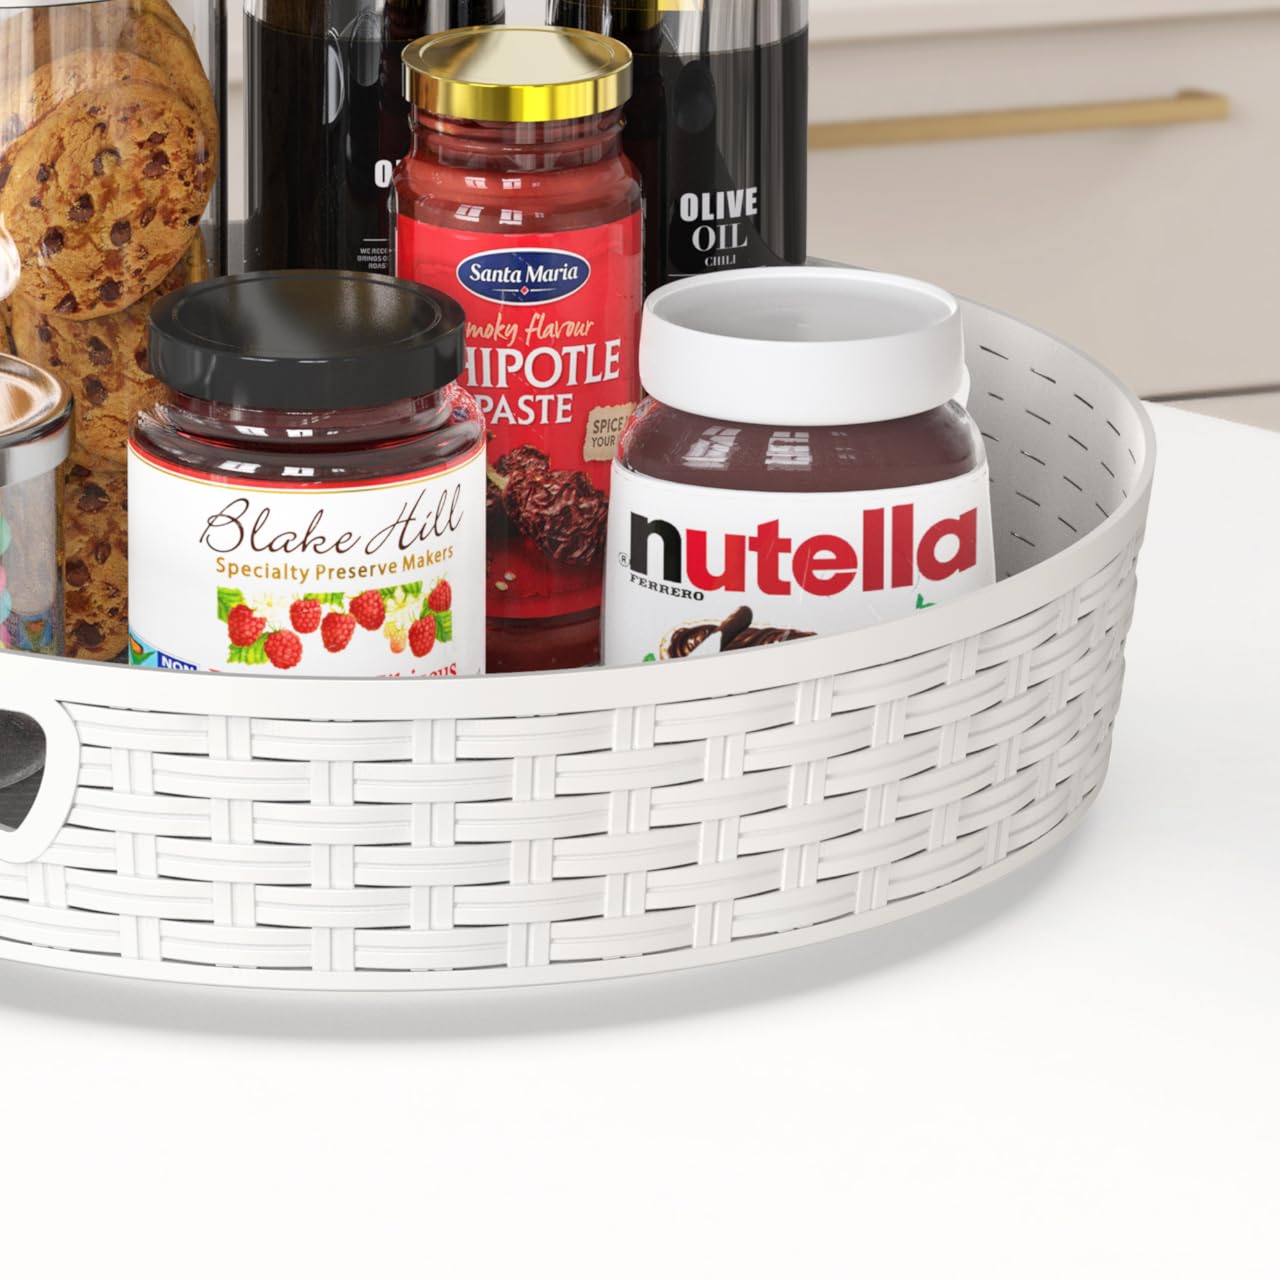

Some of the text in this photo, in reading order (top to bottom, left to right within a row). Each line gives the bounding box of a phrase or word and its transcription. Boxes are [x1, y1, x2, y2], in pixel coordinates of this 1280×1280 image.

[680, 186, 758, 222] OLIVE
[692, 222, 748, 252] OIL
[470, 263, 578, 283] Santa Maria
[466, 312, 594, 347] moky flavour
[475, 393, 573, 425] PASTE
[593, 416, 624, 434] SPICE
[591, 435, 616, 448] YOUR
[199, 483, 465, 555] Blake Hill
[215, 545, 455, 585] Specialty Preserve Makers
[630, 503, 978, 597] nutella
[630, 573, 704, 602] FERRERO
